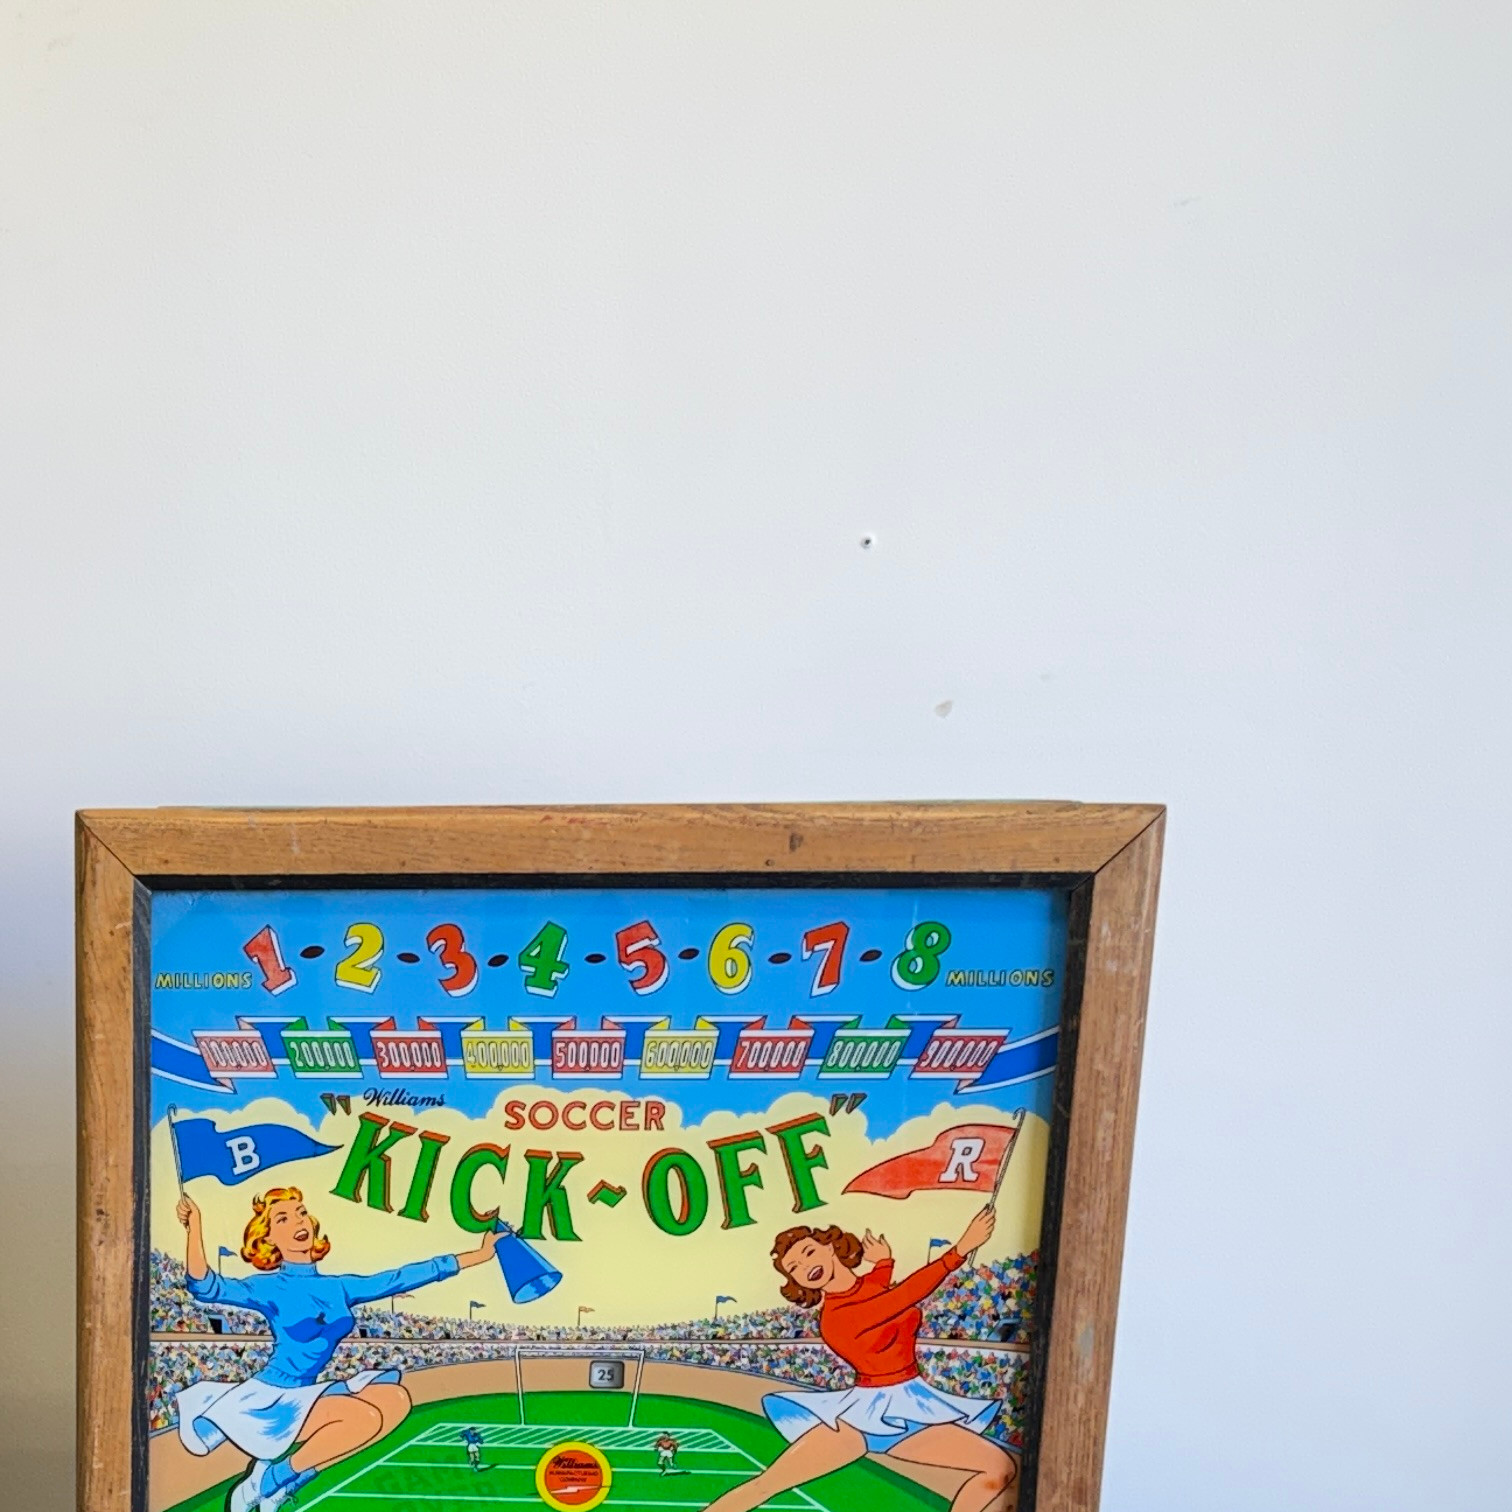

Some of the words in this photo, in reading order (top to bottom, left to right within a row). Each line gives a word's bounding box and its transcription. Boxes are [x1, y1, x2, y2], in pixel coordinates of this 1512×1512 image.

[155, 973, 252, 990] MILLIONS
[244, 924, 296, 996] 1
[334, 922, 385, 994] 2
[427, 923, 477, 998] 3
[518, 921, 569, 998] 4
[616, 920, 670, 995] 5
[707, 921, 755, 995] 6
[802, 921, 849, 997] 7
[891, 921, 951, 990] 8
[945, 970, 1054, 988] MILLIONS
[364, 1088, 445, 1107] Williams
[503, 1100, 666, 1131] SOCCER
[226, 1135, 260, 1176] B
[939, 1138, 985, 1183] R
[596, 1368, 616, 1382] 25
